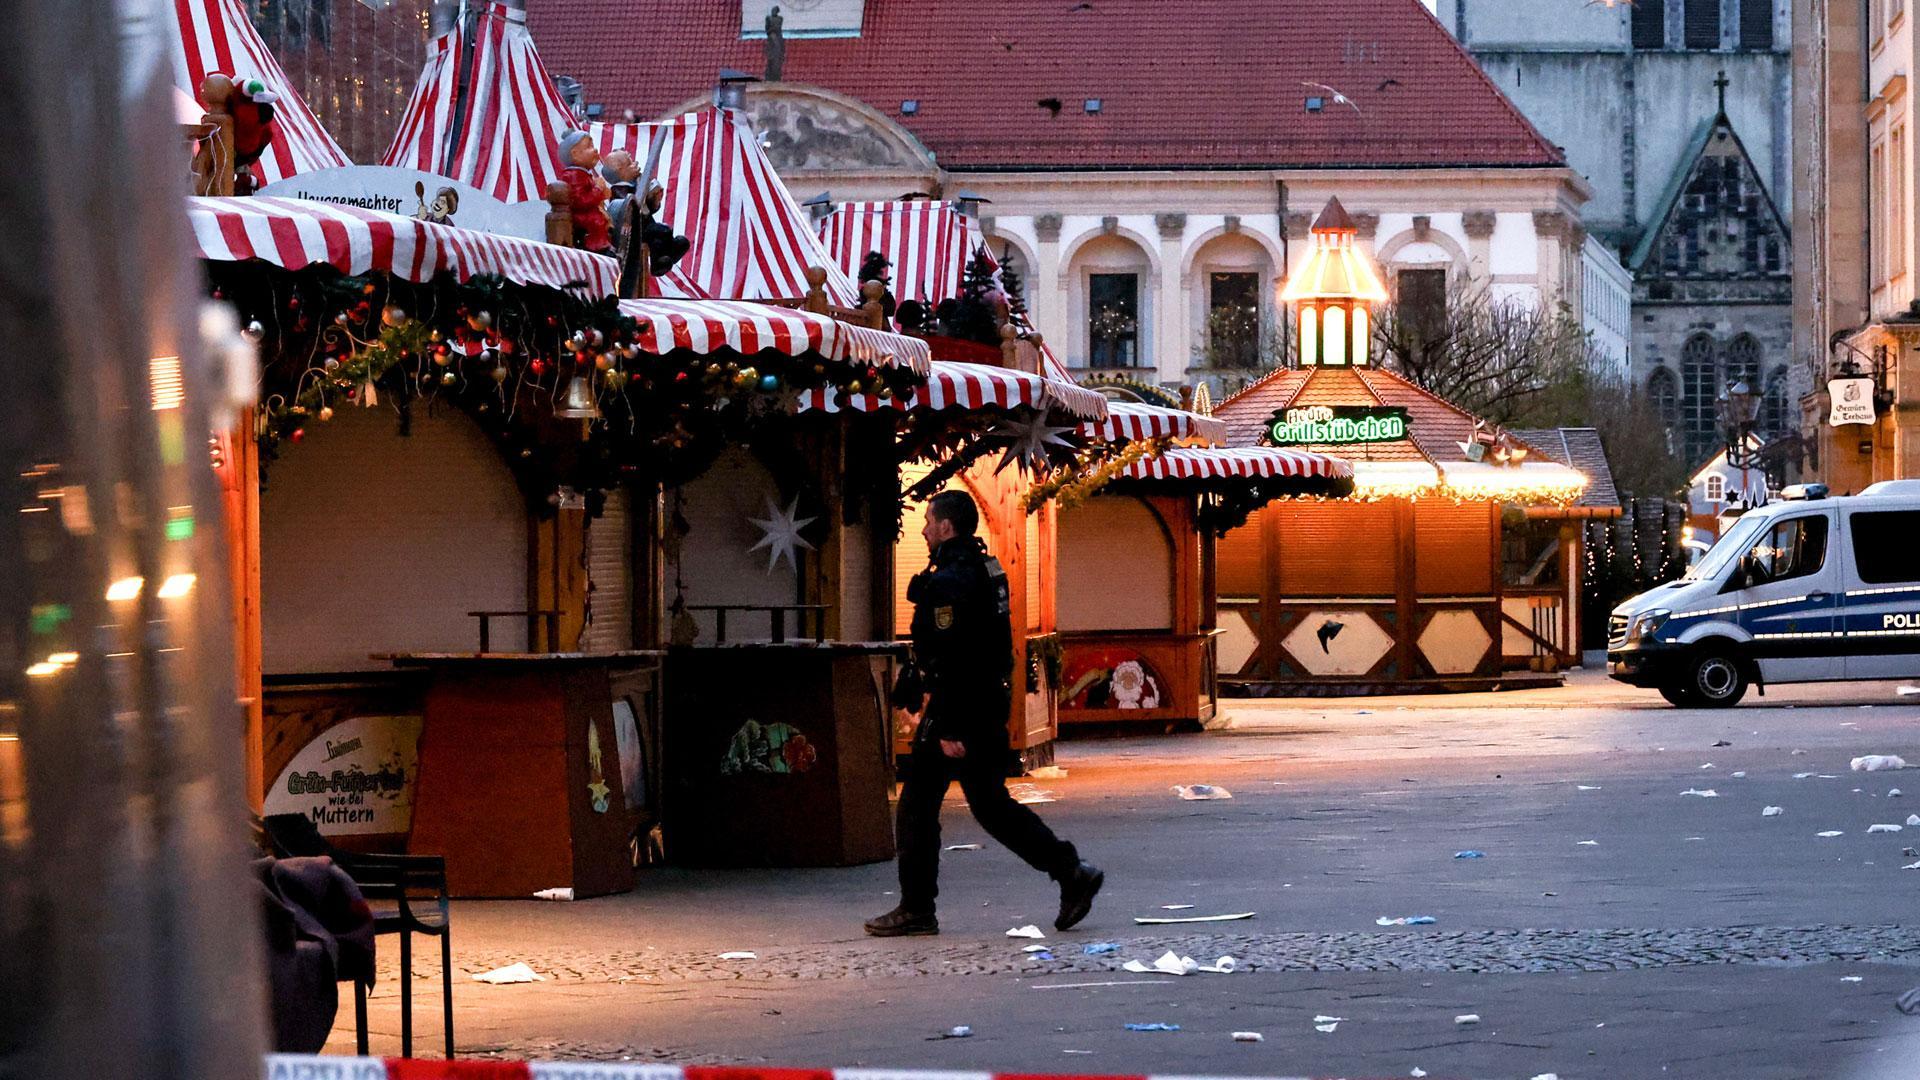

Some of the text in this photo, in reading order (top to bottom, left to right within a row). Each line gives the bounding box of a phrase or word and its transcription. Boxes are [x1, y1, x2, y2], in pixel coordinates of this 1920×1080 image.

[1273, 416, 1403, 441] Grillstübchen
[1883, 613, 1920, 628] POLI
[329, 793, 346, 806] wie
[312, 806, 374, 824] Muttern
